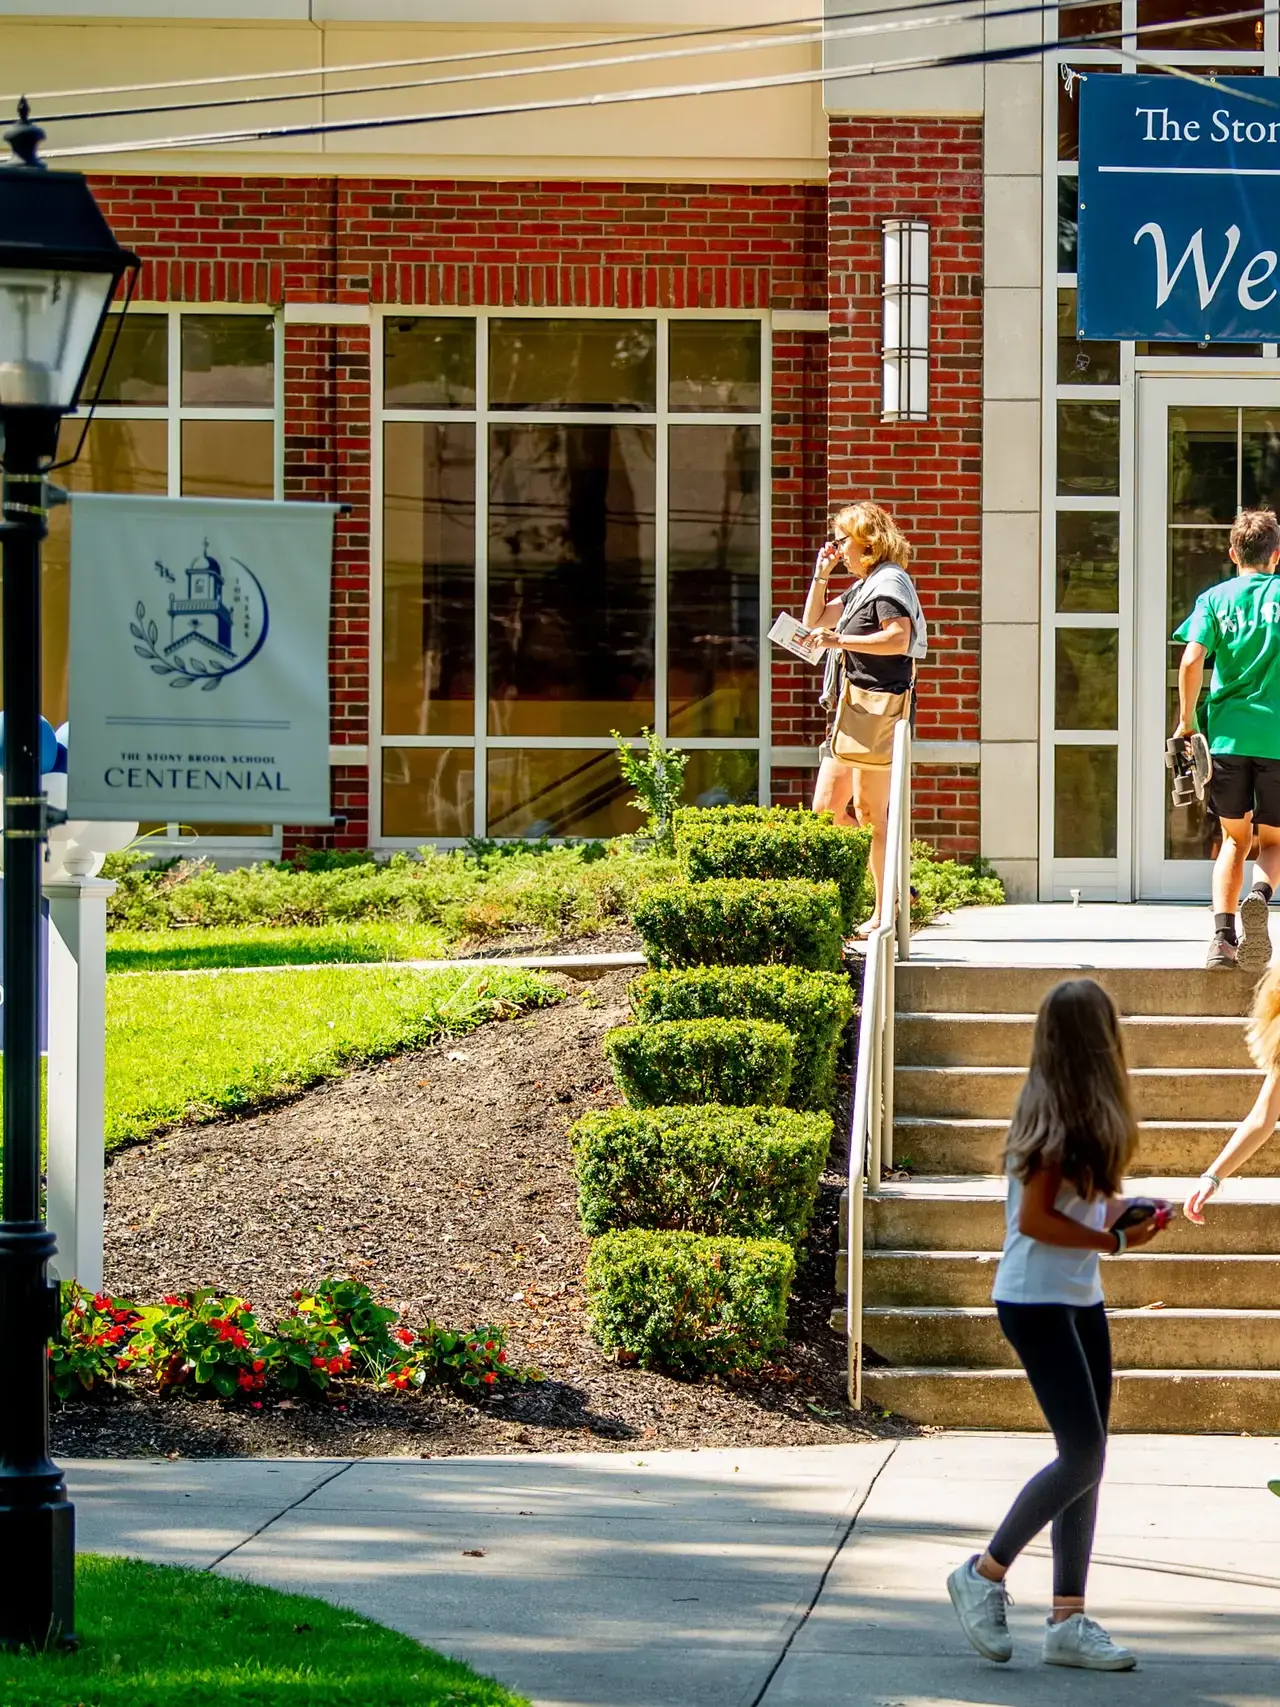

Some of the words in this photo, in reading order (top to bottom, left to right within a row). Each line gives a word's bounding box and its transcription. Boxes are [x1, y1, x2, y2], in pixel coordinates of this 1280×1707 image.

[1135, 106, 1200, 143] The
[121, 752, 140, 761] THE
[146, 753, 183, 762] STONY
[188, 754, 227, 763] BROOK
[232, 755, 276, 764] SCHOOL
[104, 766, 291, 791] CENTENNIAL
